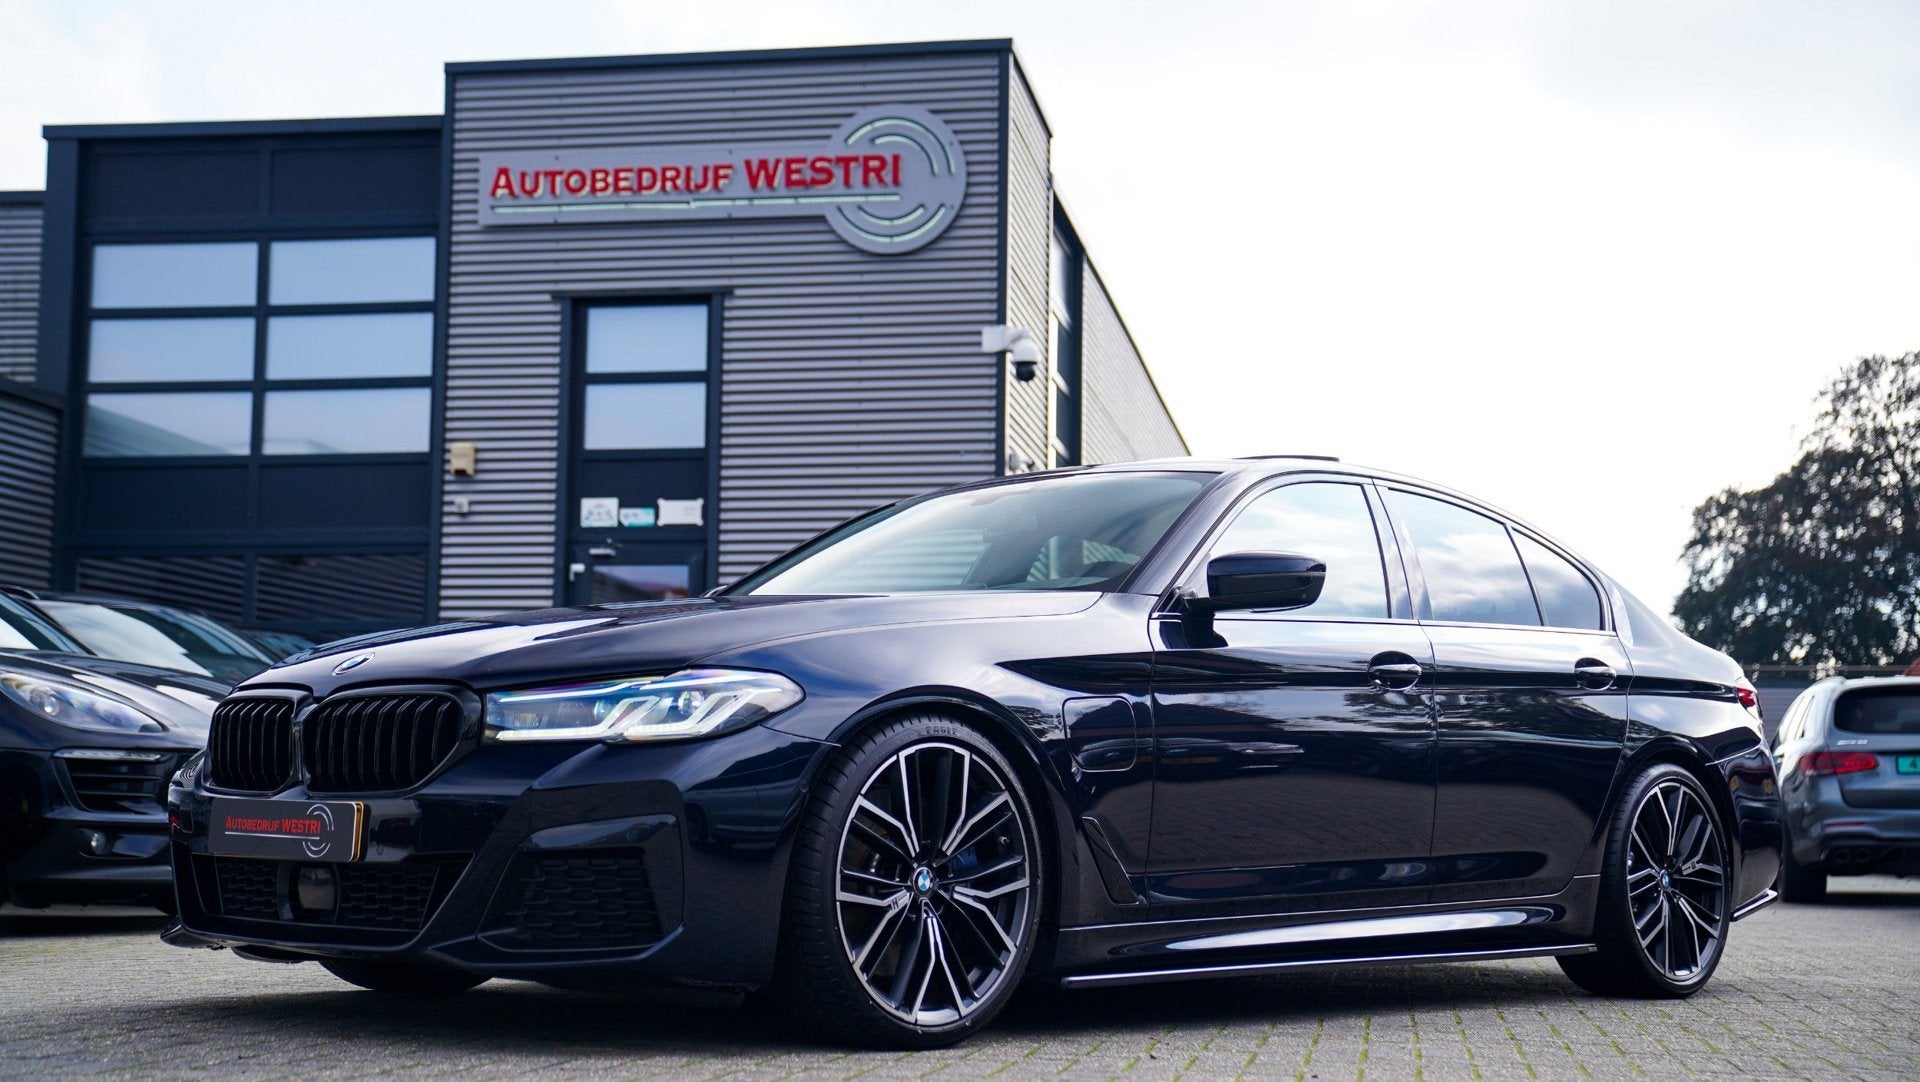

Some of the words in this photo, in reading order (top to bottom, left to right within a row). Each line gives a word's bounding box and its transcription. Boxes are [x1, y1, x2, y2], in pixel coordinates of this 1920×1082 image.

[490, 164, 733, 198] AUTOBEDRIJF
[744, 153, 901, 188] WESTRI
[925, 725, 958, 736] EAGLE
[225, 815, 280, 832] AUTOBEDRIJF
[281, 819, 321, 834] WESTRI
